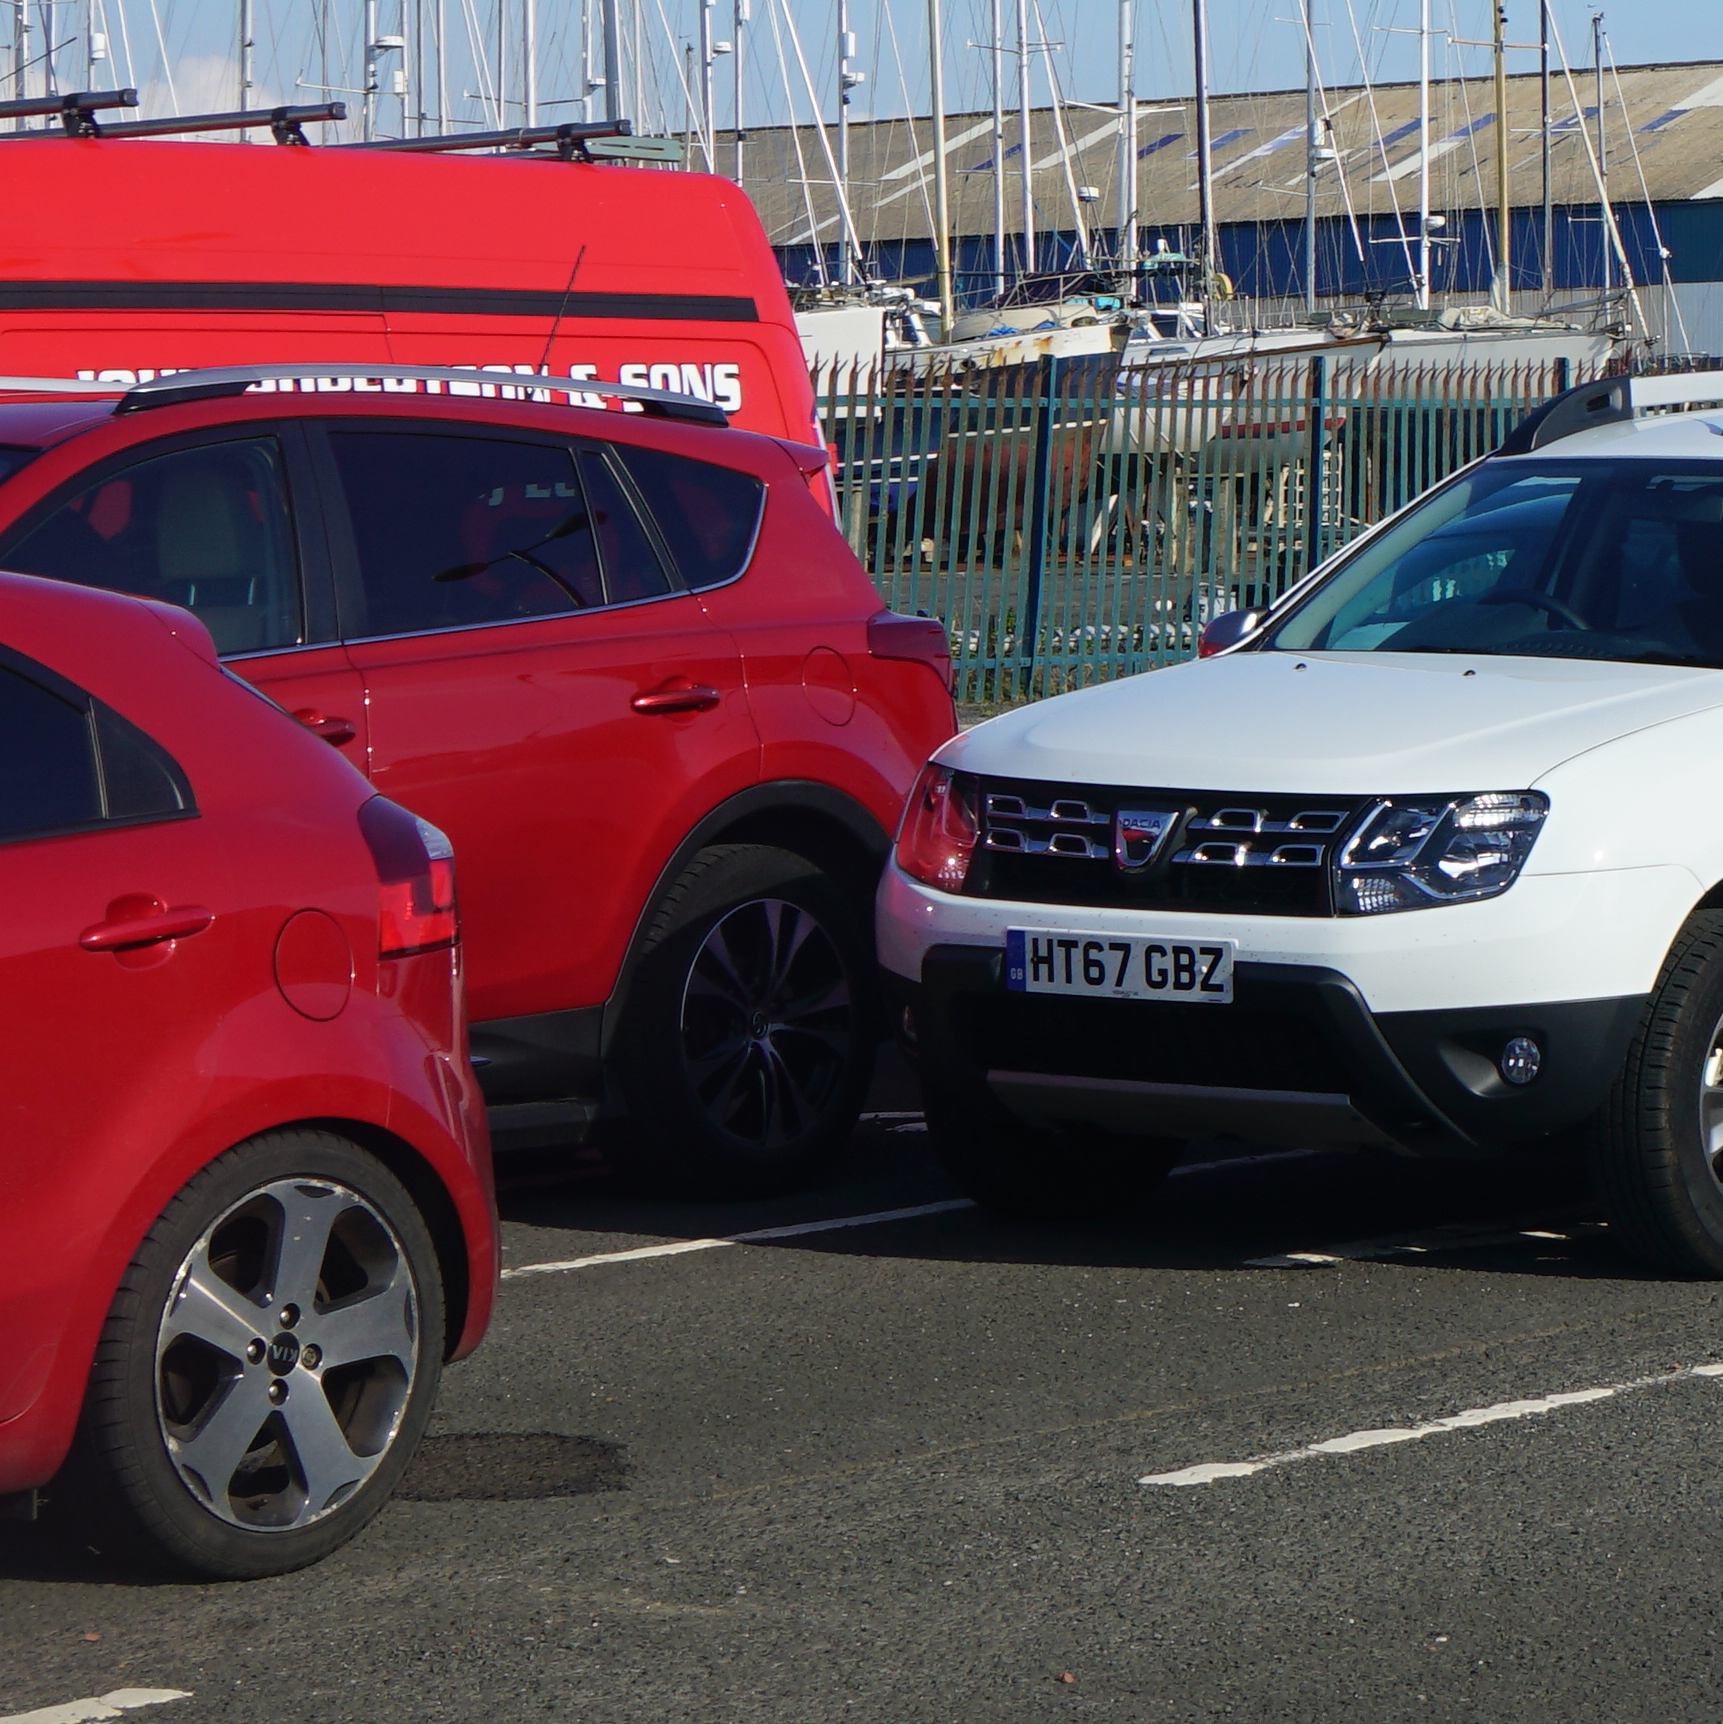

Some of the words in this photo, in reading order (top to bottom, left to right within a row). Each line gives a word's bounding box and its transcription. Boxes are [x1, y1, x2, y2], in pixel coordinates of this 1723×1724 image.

[619, 363, 742, 413] SONS
[1122, 818, 1160, 829] DACIA
[1010, 968, 1024, 980] GB
[1030, 937, 1132, 987] HT67
[1145, 944, 1225, 992] GBZ
[272, 1344, 298, 1363] KIA
